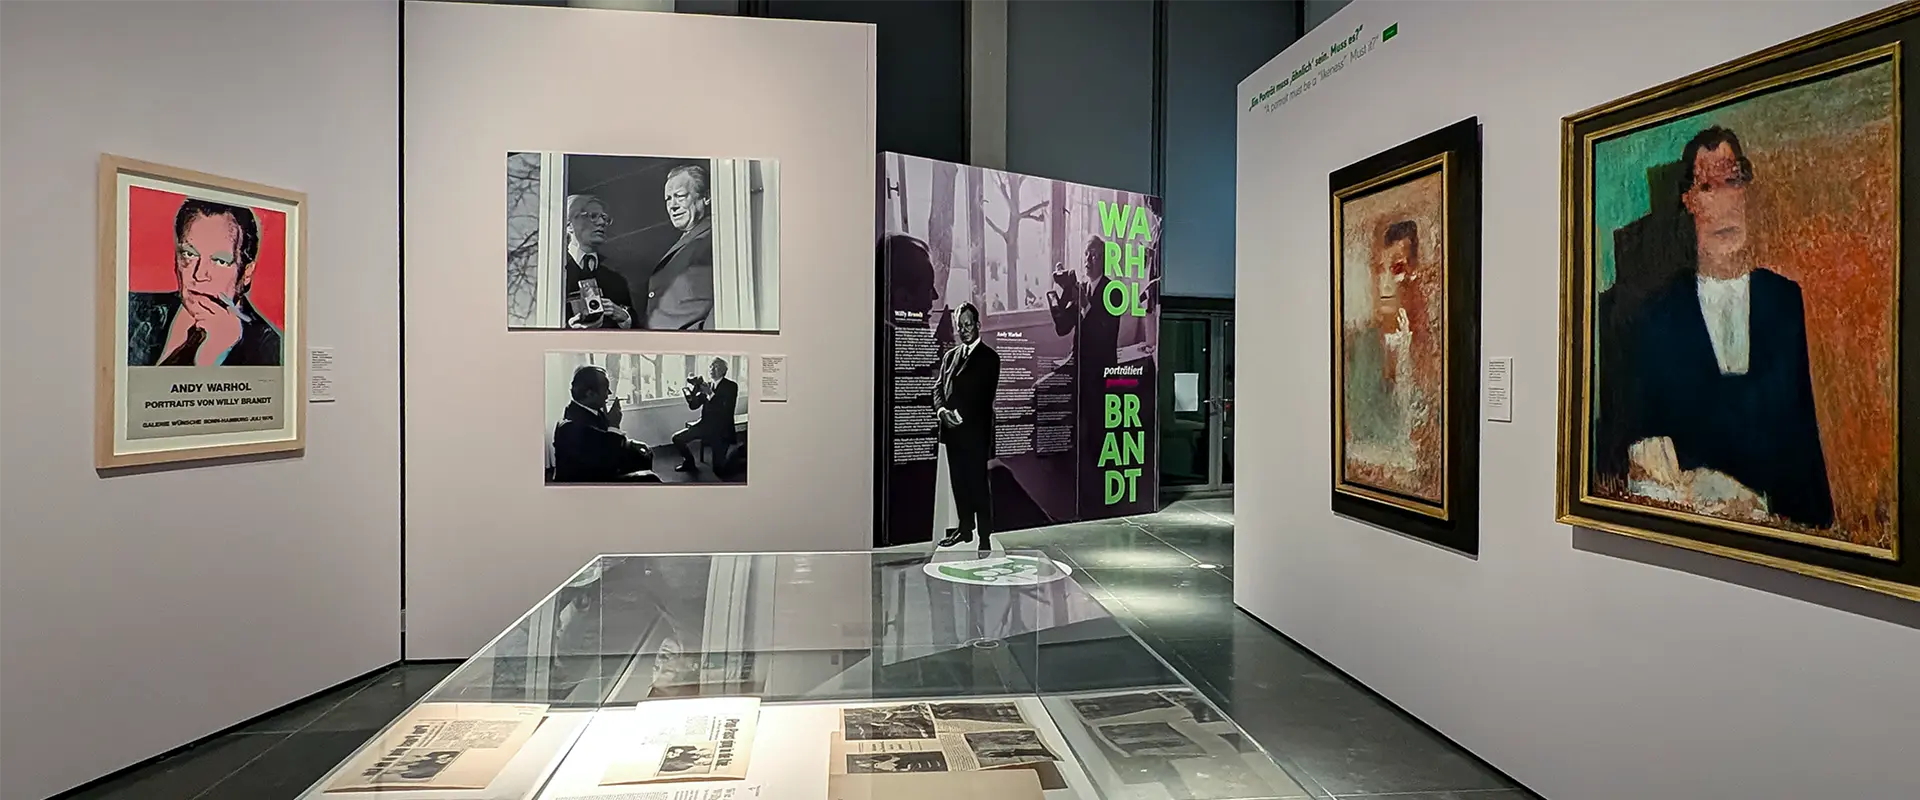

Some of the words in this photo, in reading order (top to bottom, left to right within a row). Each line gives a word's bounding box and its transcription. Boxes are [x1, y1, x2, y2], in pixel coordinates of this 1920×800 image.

[1303, 80, 1312, 92] be
[1349, 44, 1367, 63] Must
[1330, 42, 1347, 57] Muss
[1097, 200, 1152, 242] WA
[1104, 241, 1146, 279] RH
[1102, 280, 1147, 317] OL
[170, 384, 203, 393] ANDY
[206, 382, 252, 392] WARHOL
[1102, 365, 1144, 378] porträtiert
[145, 399, 195, 408] PORTRAITS
[1104, 393, 1143, 428] BR
[1097, 431, 1145, 468] AN
[1104, 468, 1143, 505] DT
